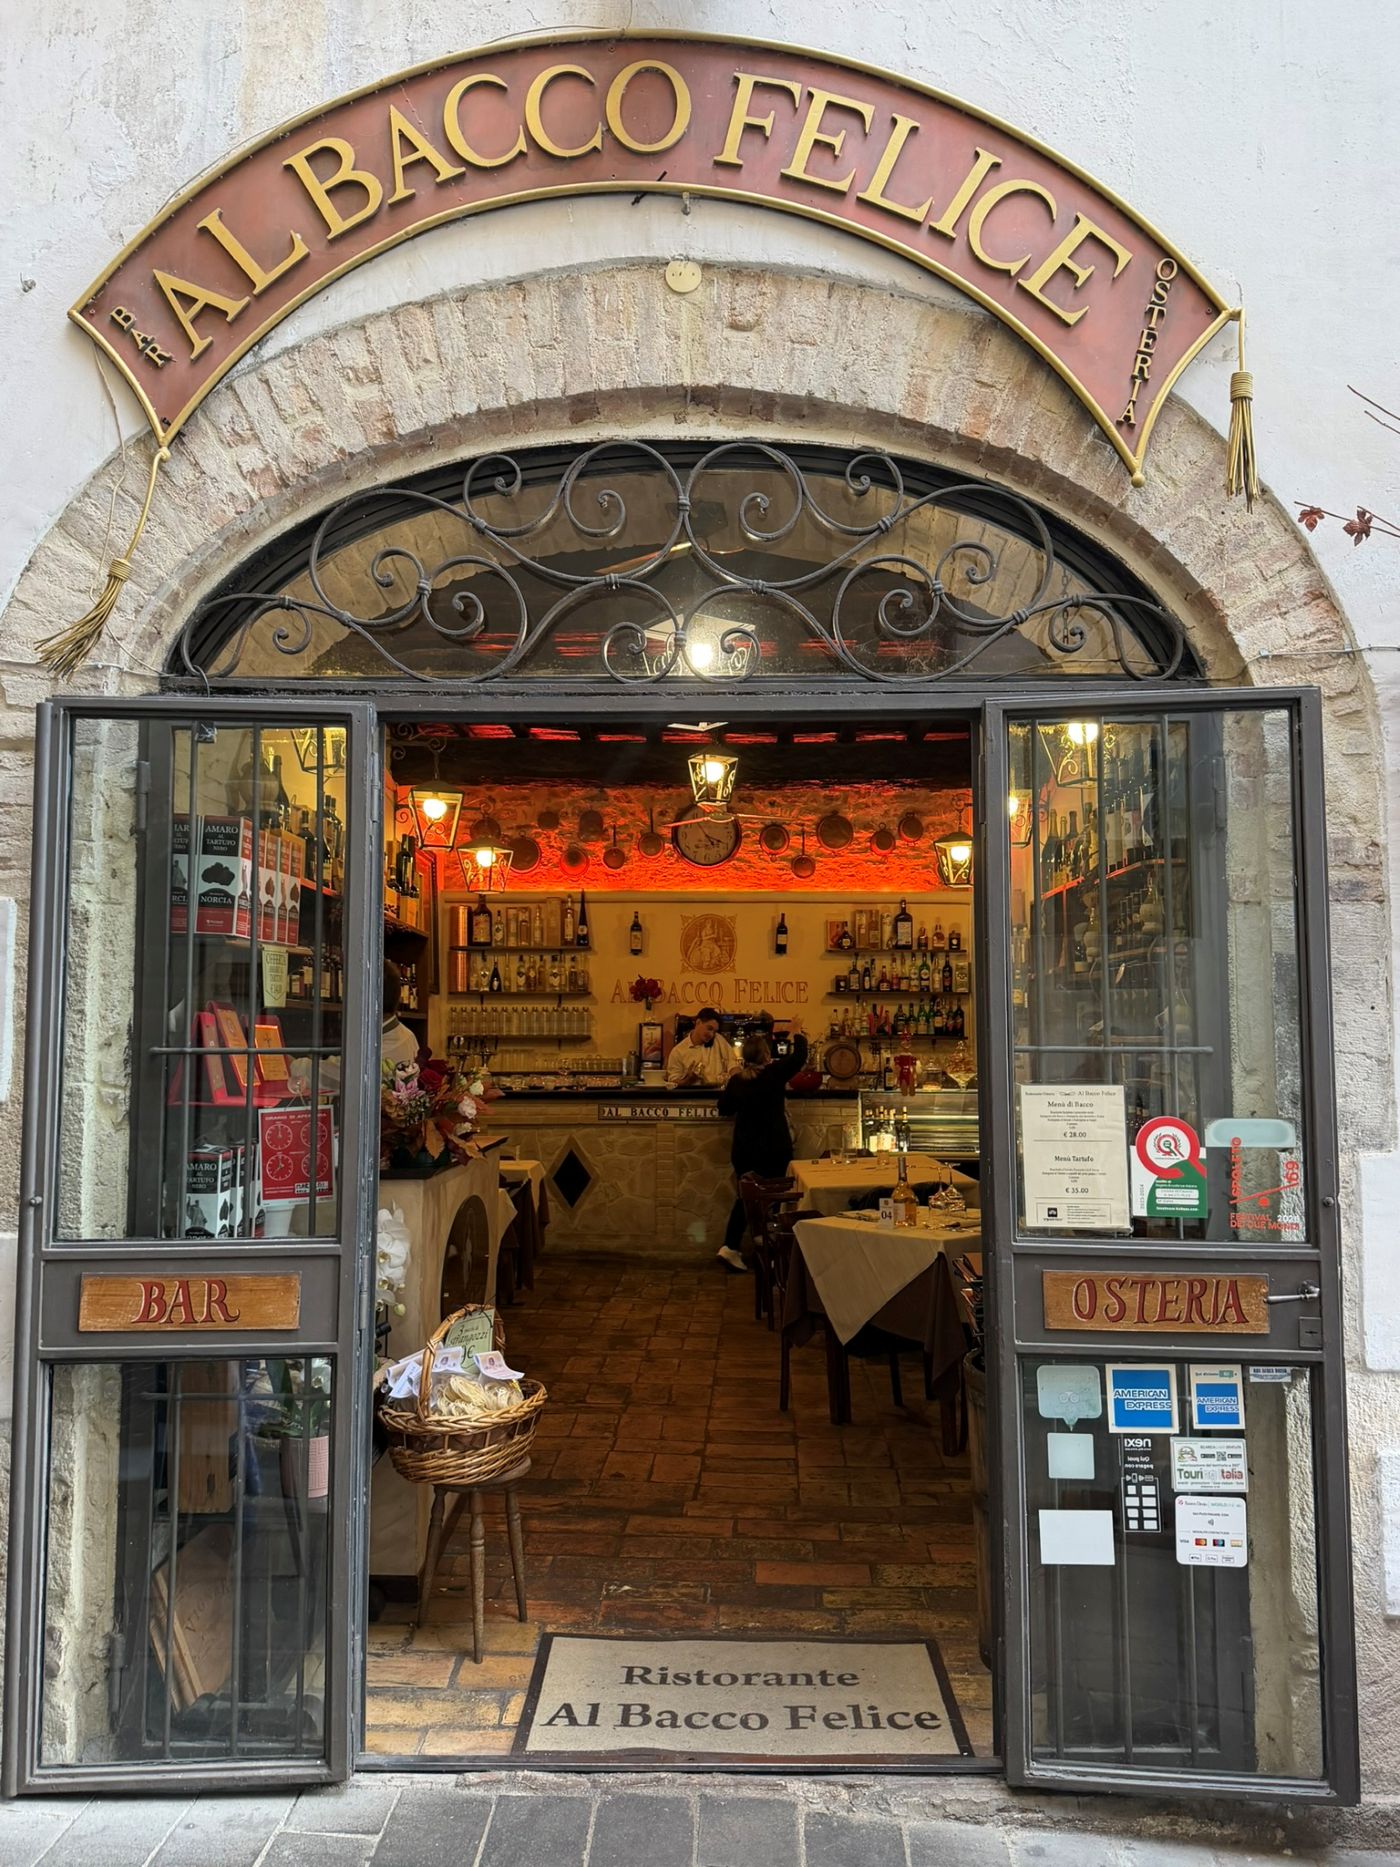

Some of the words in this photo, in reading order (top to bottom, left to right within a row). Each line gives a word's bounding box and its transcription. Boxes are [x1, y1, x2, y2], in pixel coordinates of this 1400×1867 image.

[153, 208, 310, 361] AL
[283, 59, 692, 241] BACCO
[712, 72, 1133, 327] FELICE
[110, 304, 174, 369] BAR
[1115, 257, 1179, 427] OSTERIA
[205, 825, 239, 834] AMARO
[206, 838, 236, 846] TARTUFO
[200, 894, 233, 905] NORCIA
[734, 978, 809, 1004] FELICE
[631, 1107, 669, 1117] BACCO
[679, 1107, 719, 1117] FELIC
[881, 1210, 893, 1220] 04
[131, 1280, 241, 1324] BAR
[1072, 1276, 1250, 1326] OSTERIA
[1114, 1389, 1168, 1398] AMERICAN
[1197, 1397, 1237, 1405] AMERICAN
[1126, 1401, 1172, 1410] EXPRESS
[619, 1665, 860, 1688] Ristorante
[540, 1702, 599, 1728] Al
[614, 1703, 770, 1732] Bacco
[783, 1704, 942, 1732] Felice
